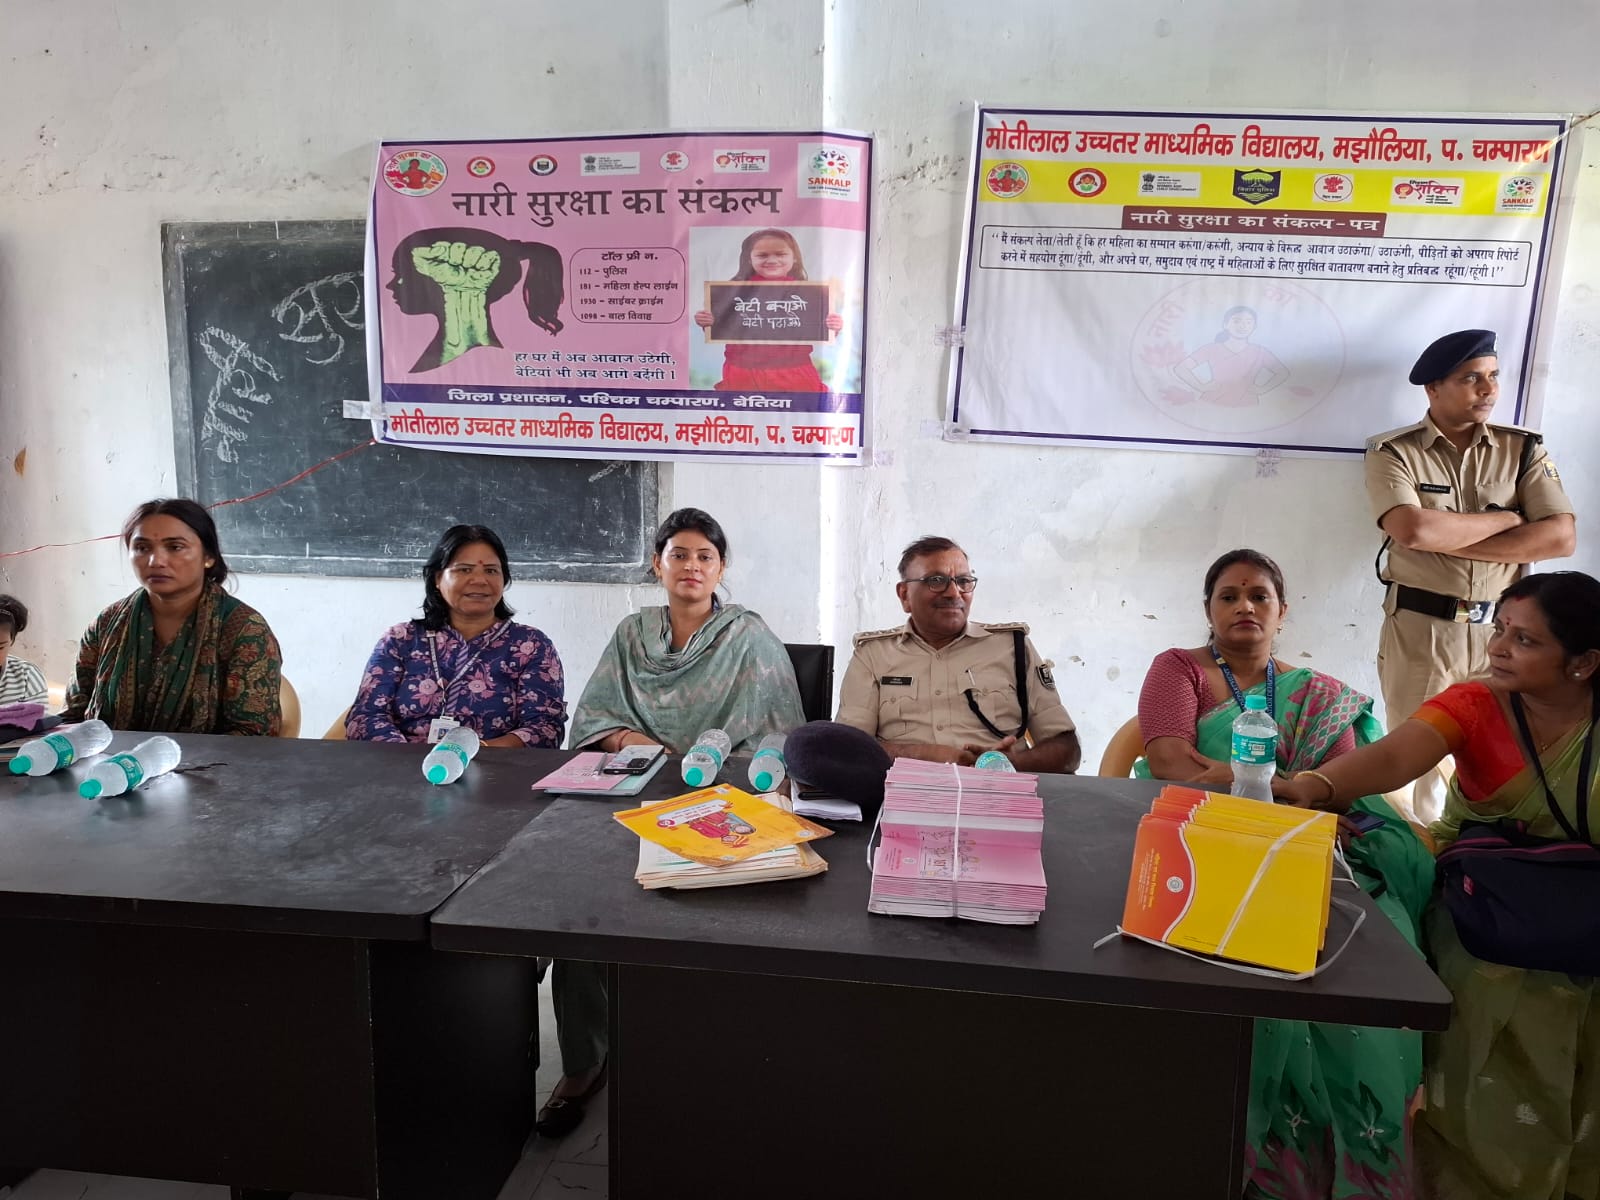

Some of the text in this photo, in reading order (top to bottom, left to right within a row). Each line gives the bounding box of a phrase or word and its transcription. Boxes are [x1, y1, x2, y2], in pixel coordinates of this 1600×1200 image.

[986, 120, 1551, 163] मोतीलाल उच्चतर माध्यमिक विद्यालय, मझौलिया, प. चम्पारण
[807, 177, 851, 187] SANKALP
[451, 178, 783, 226] नारी सुरक्षा का संकल्प
[1130, 209, 1172, 225] नारी
[1178, 213, 1232, 230] सुरक्षा
[1238, 216, 1267, 228] का
[601, 251, 622, 261] टॉल
[626, 250, 640, 261] फ्री
[1085, 234, 1096, 246] कि
[1097, 237, 1107, 248] हर
[1109, 234, 1134, 249] महिला
[1136, 239, 1148, 249] का
[1150, 239, 1176, 249] सम्मान
[1237, 242, 1264, 251] अन्याय
[1266, 240, 1275, 252] के
[1307, 244, 1336, 254] आवाज
[1419, 245, 1448, 260] पीड़ितों
[1451, 245, 1464, 259] को
[1497, 247, 1519, 260] रिपोर्ट
[603, 265, 627, 278] पुलिस
[1001, 249, 1018, 261] करने
[1029, 250, 1057, 264] सहयोग
[1099, 251, 1114, 264] और
[1117, 252, 1137, 265] अपने
[1139, 256, 1152, 267] घर,
[1156, 256, 1184, 269] समुदाय
[1186, 254, 1198, 268] एवं
[1228, 255, 1265, 270] महिलाओं
[1267, 257, 1276, 270] के
[1279, 257, 1295, 272] लिए
[1297, 258, 1326, 275] सुरक्षित
[1328, 262, 1365, 273] वातावरण
[1367, 261, 1390, 274] बनाने
[1392, 261, 1405, 279] हेतु
[603, 280, 630, 290] महिला
[633, 281, 650, 290] हेल्प
[653, 280, 678, 290] लाईन
[734, 295, 808, 313] बेटी बचाओ
[608, 312, 625, 320] बाल
[628, 310, 652, 321] विवाह
[515, 350, 676, 365] हर घर में अब आवाज उठेगी,
[515, 366, 551, 377] बेटियां
[556, 366, 571, 378] भी
[576, 368, 597, 378] अब
[602, 367, 628, 378] आगे
[447, 388, 494, 402] जिला
[579, 392, 640, 405] पश्चिम
[734, 395, 792, 408] बेतिया
[390, 408, 855, 446] मोतीलाल उच्चतर माध्यमिक विद्यालय, मझौलिया, प. चम्पारण
